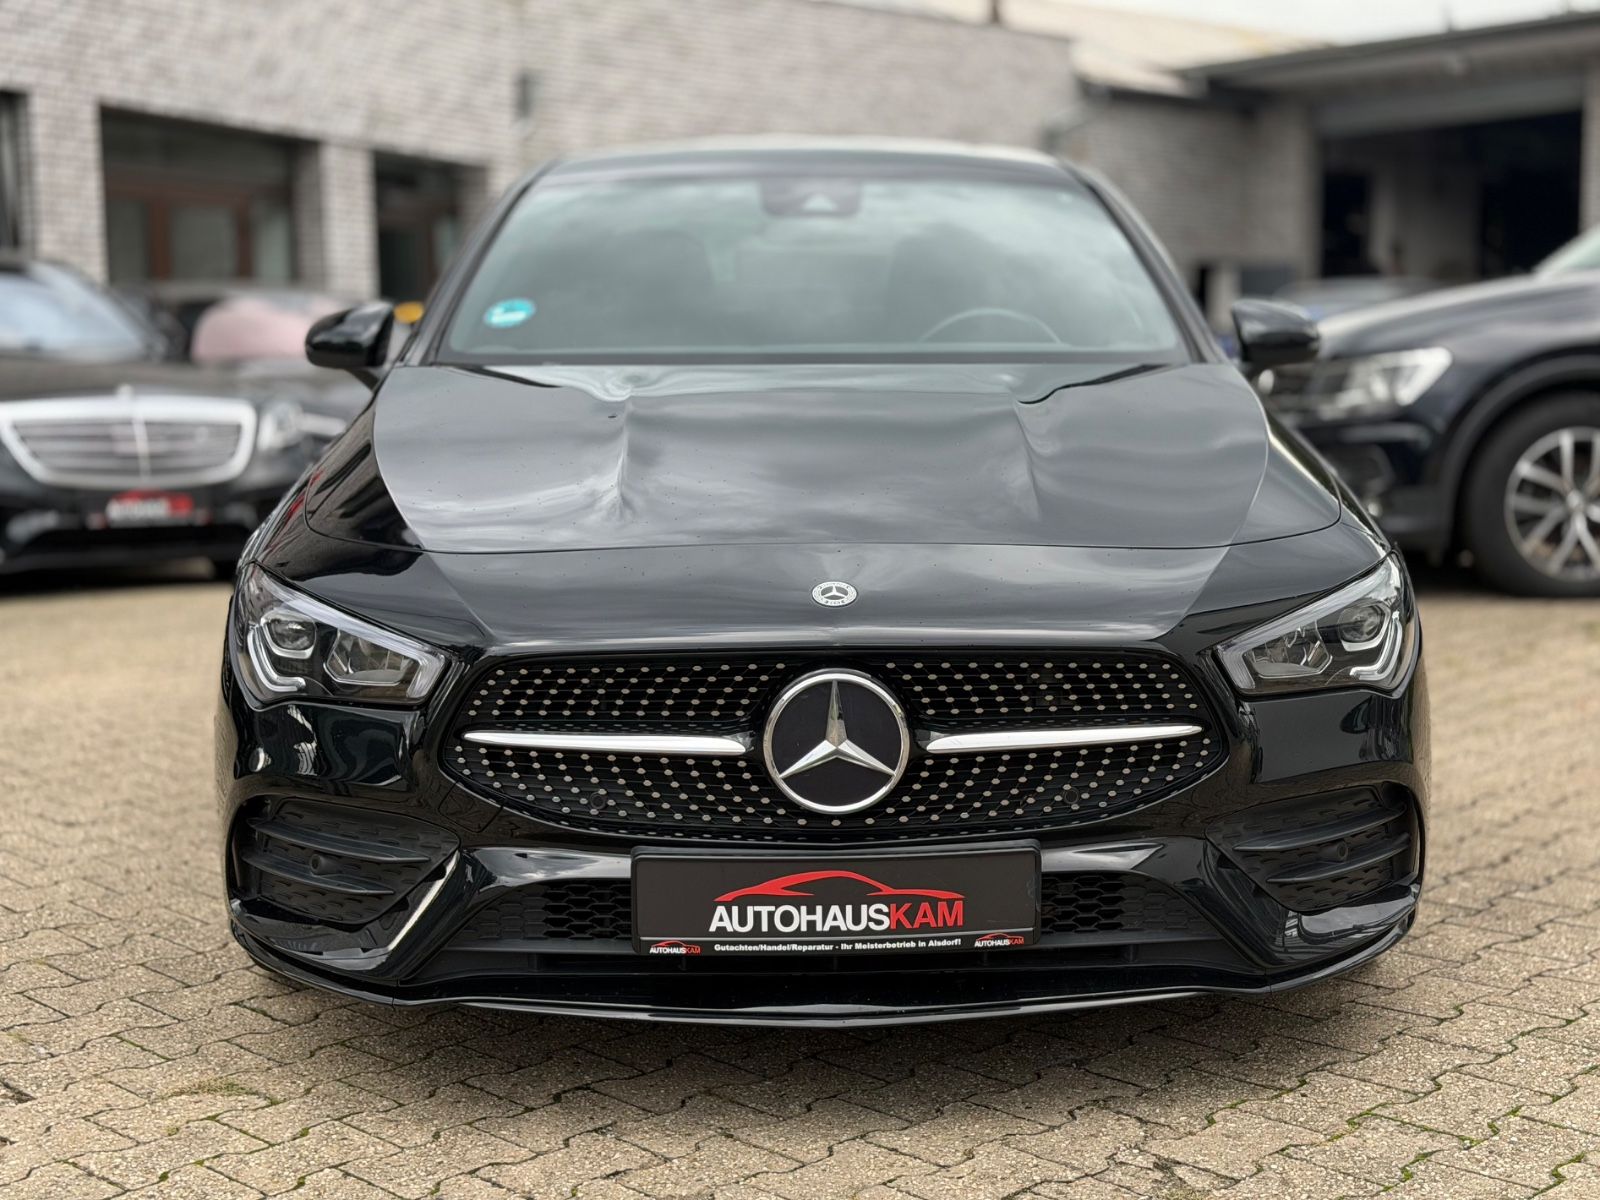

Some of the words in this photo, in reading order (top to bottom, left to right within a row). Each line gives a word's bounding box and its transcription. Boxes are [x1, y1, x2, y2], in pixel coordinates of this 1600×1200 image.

[708, 900, 964, 933] AUTOHAUSKAM
[714, 943, 834, 953] Gutachten/Handel/Reparatur
[840, 942, 852, 950] Ihr
[854, 940, 917, 950] Meisterbetrieb
[928, 938, 962, 947] Alsdorf!
